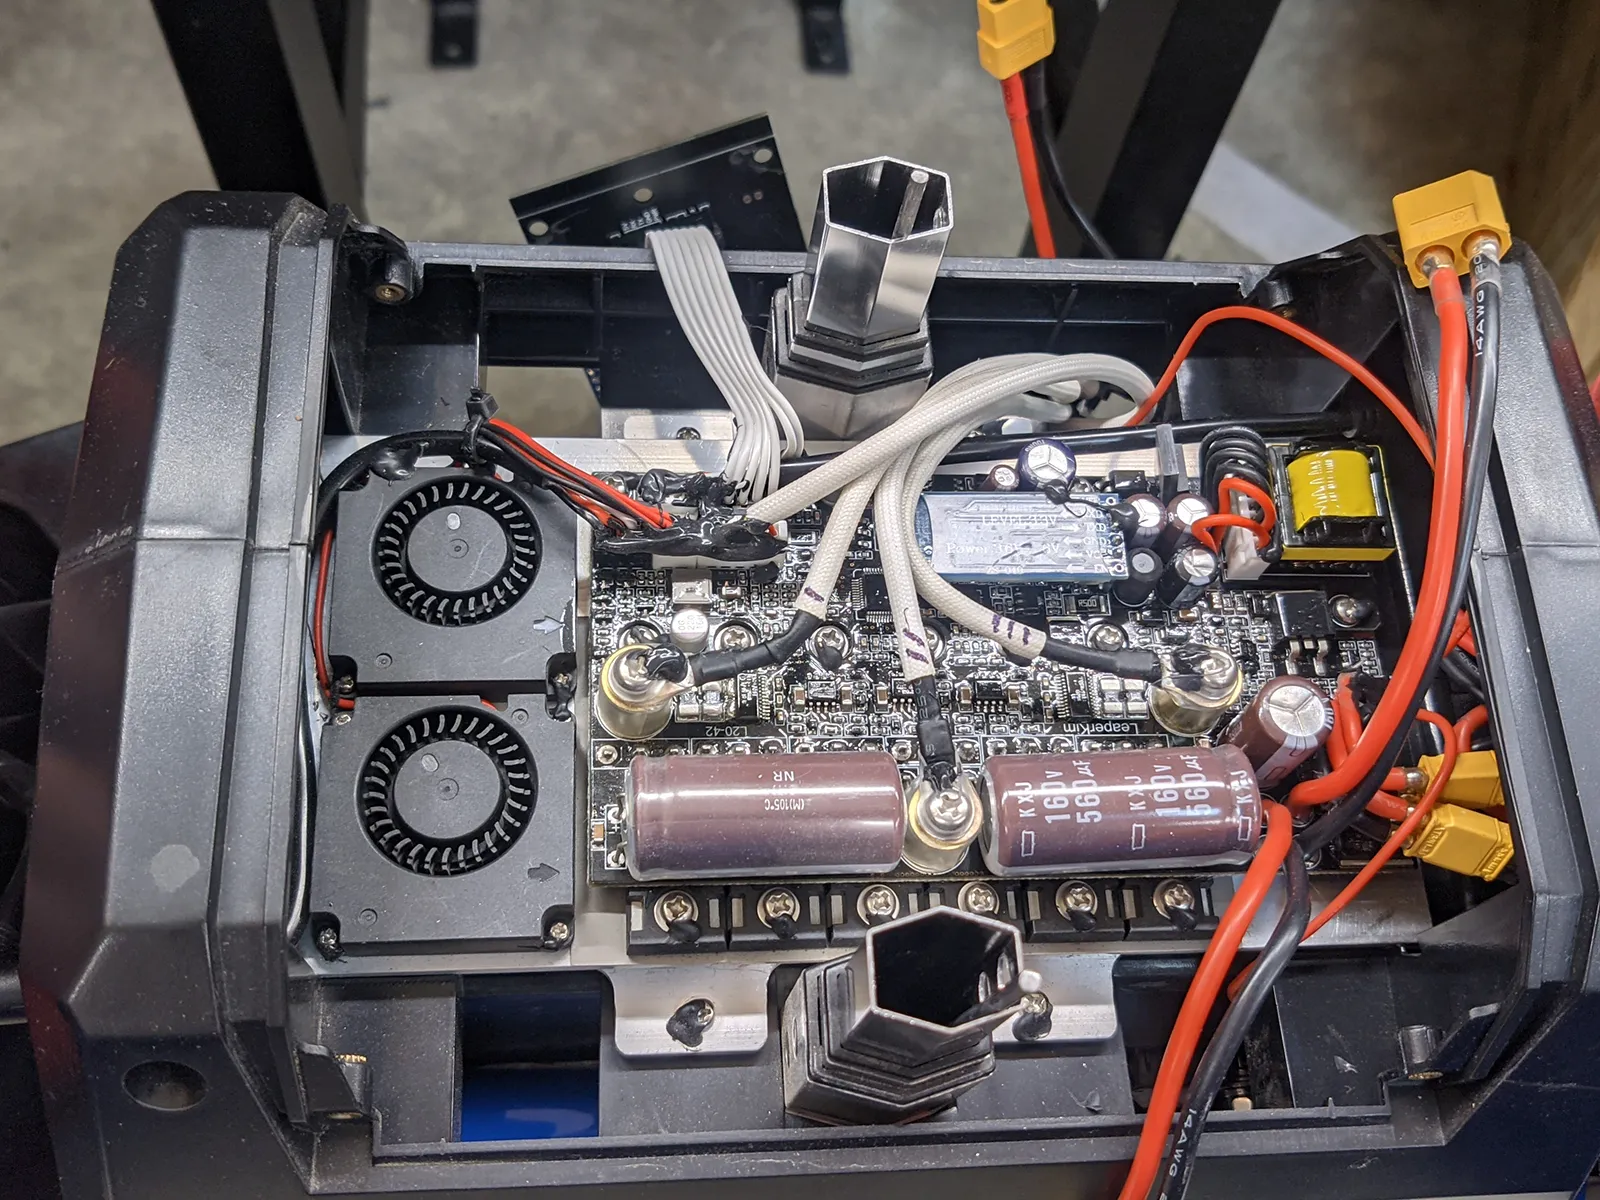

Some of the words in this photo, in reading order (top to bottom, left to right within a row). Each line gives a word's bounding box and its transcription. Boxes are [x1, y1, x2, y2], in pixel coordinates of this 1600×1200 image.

[1475, 289, 1485, 357] 14AWG
[705, 726, 748, 737] L20-42
[1063, 723, 1139, 735] LeaperKim
[772, 770, 795, 782] NR
[1124, 775, 1146, 811] KXJ
[1015, 782, 1037, 818] KXJ
[1169, 1108, 1198, 1177] 14AWG
